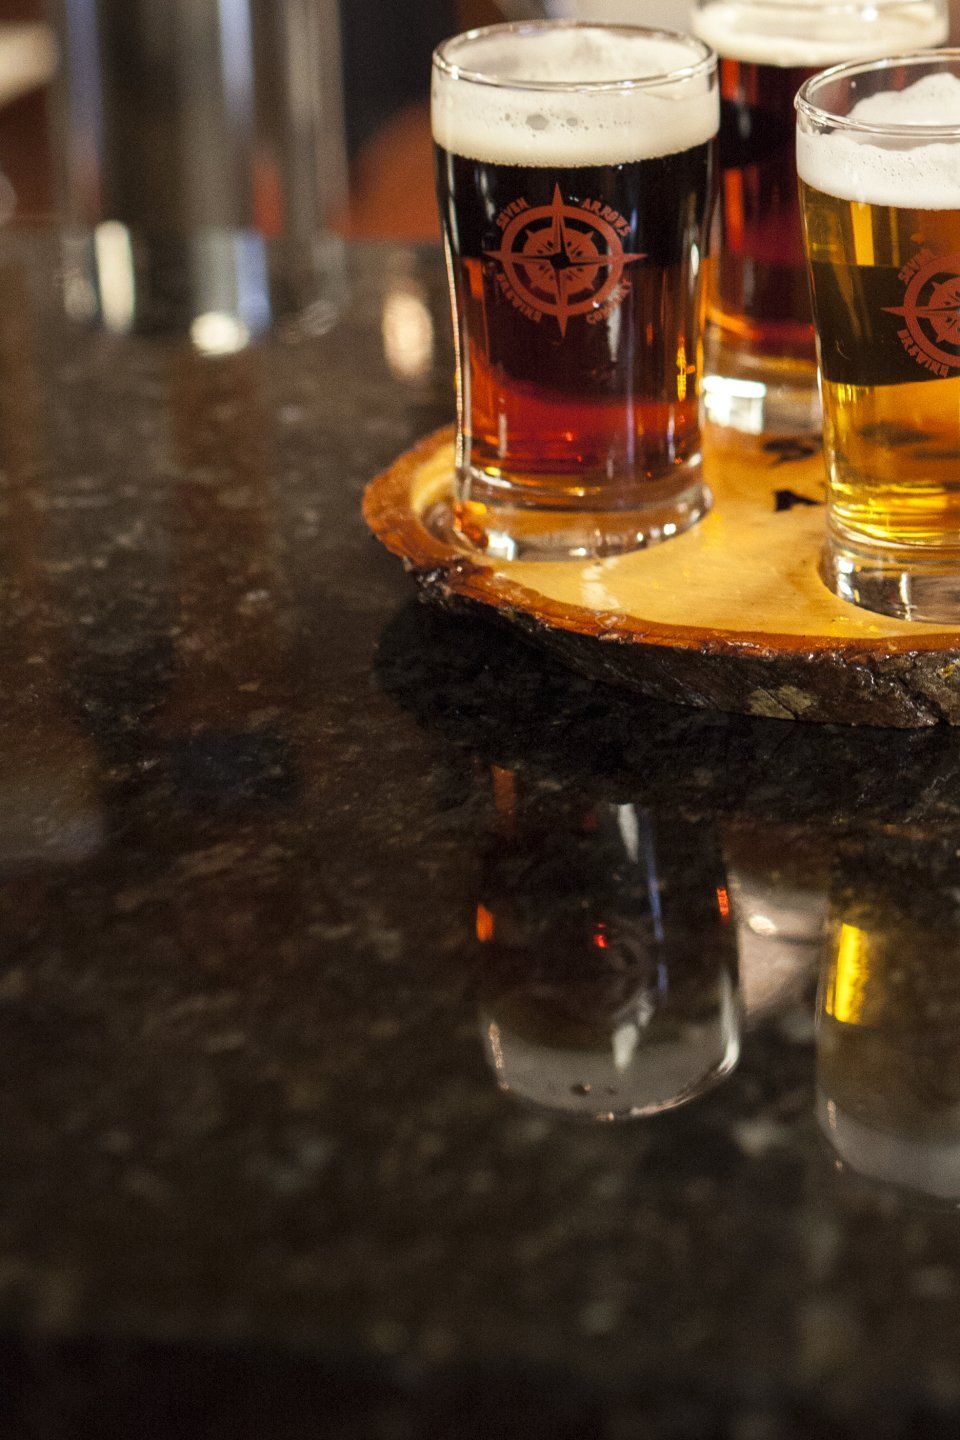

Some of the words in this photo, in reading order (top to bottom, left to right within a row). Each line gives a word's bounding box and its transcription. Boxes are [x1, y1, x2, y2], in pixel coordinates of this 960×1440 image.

[496, 196, 529, 231] SEVEN
[581, 197, 632, 237] ARROWS
[896, 328, 950, 378] BREWING
